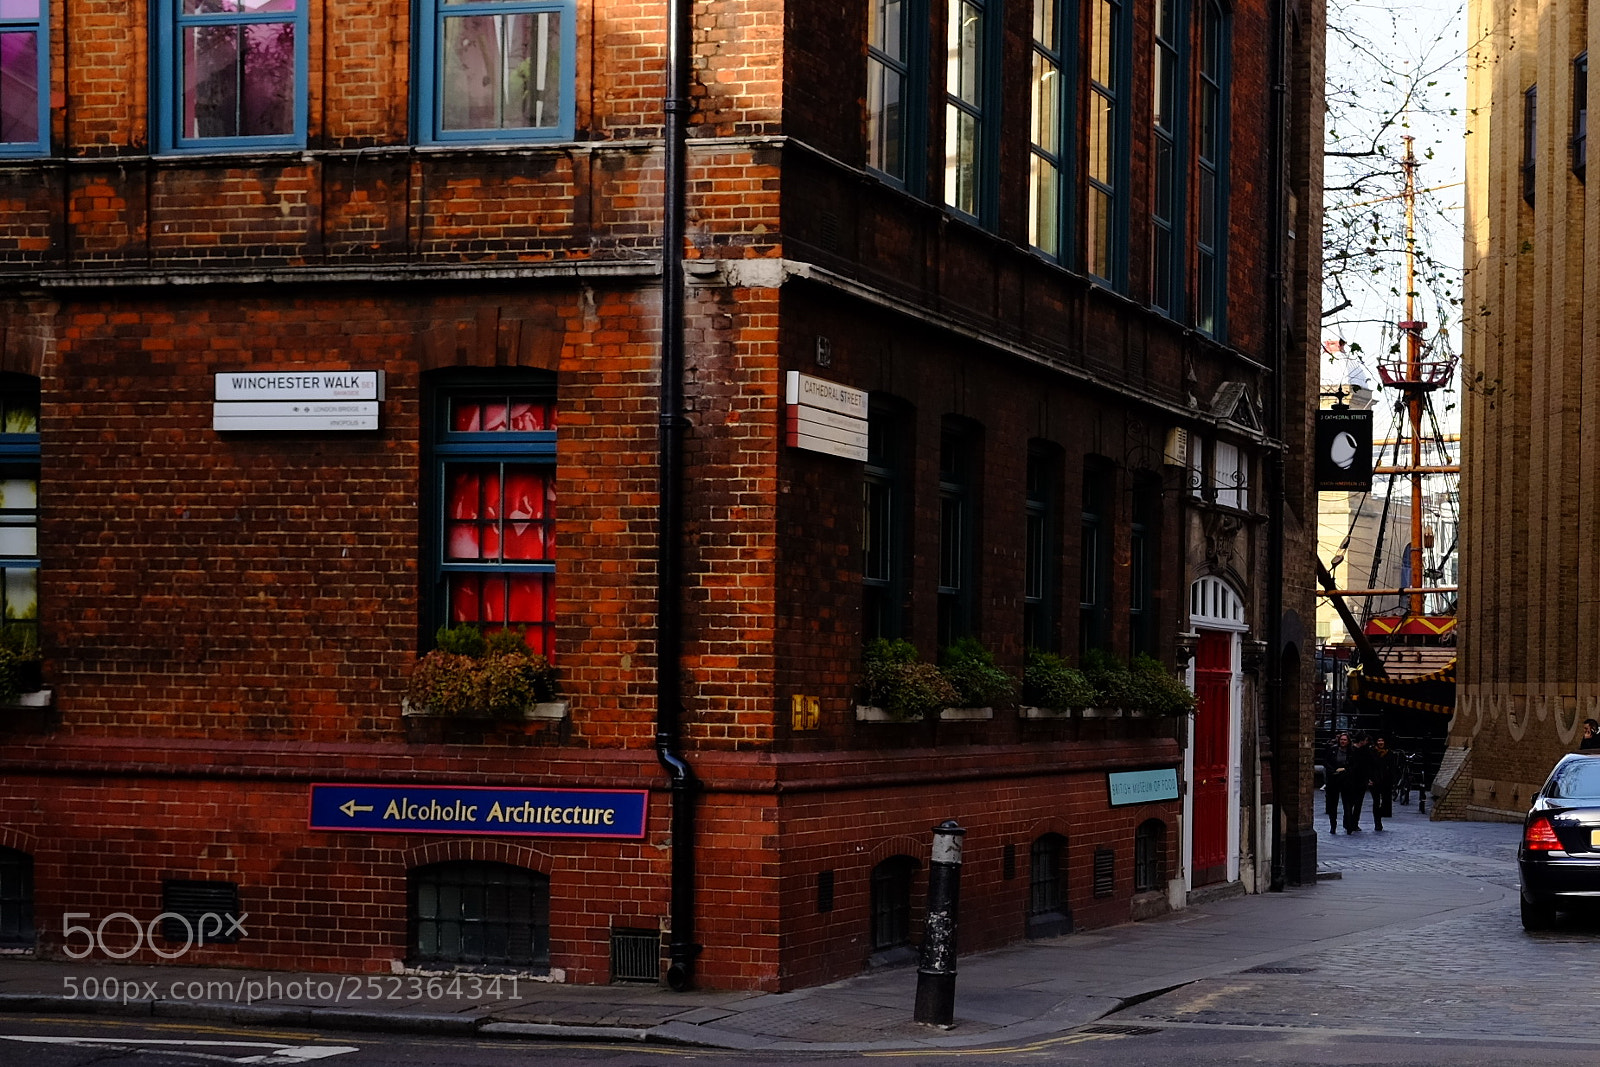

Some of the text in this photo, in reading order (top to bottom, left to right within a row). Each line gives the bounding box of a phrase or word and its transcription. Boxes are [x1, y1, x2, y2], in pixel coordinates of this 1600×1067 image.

[232, 376, 320, 389] WINCHESTER
[324, 376, 360, 389] WALK
[804, 380, 839, 401] CATHEDRAL
[840, 390, 862, 406] STREET
[1112, 778, 1175, 796] BRITISH MUSEUM OF FOOD
[383, 797, 615, 826] Alcoholic Architecture
